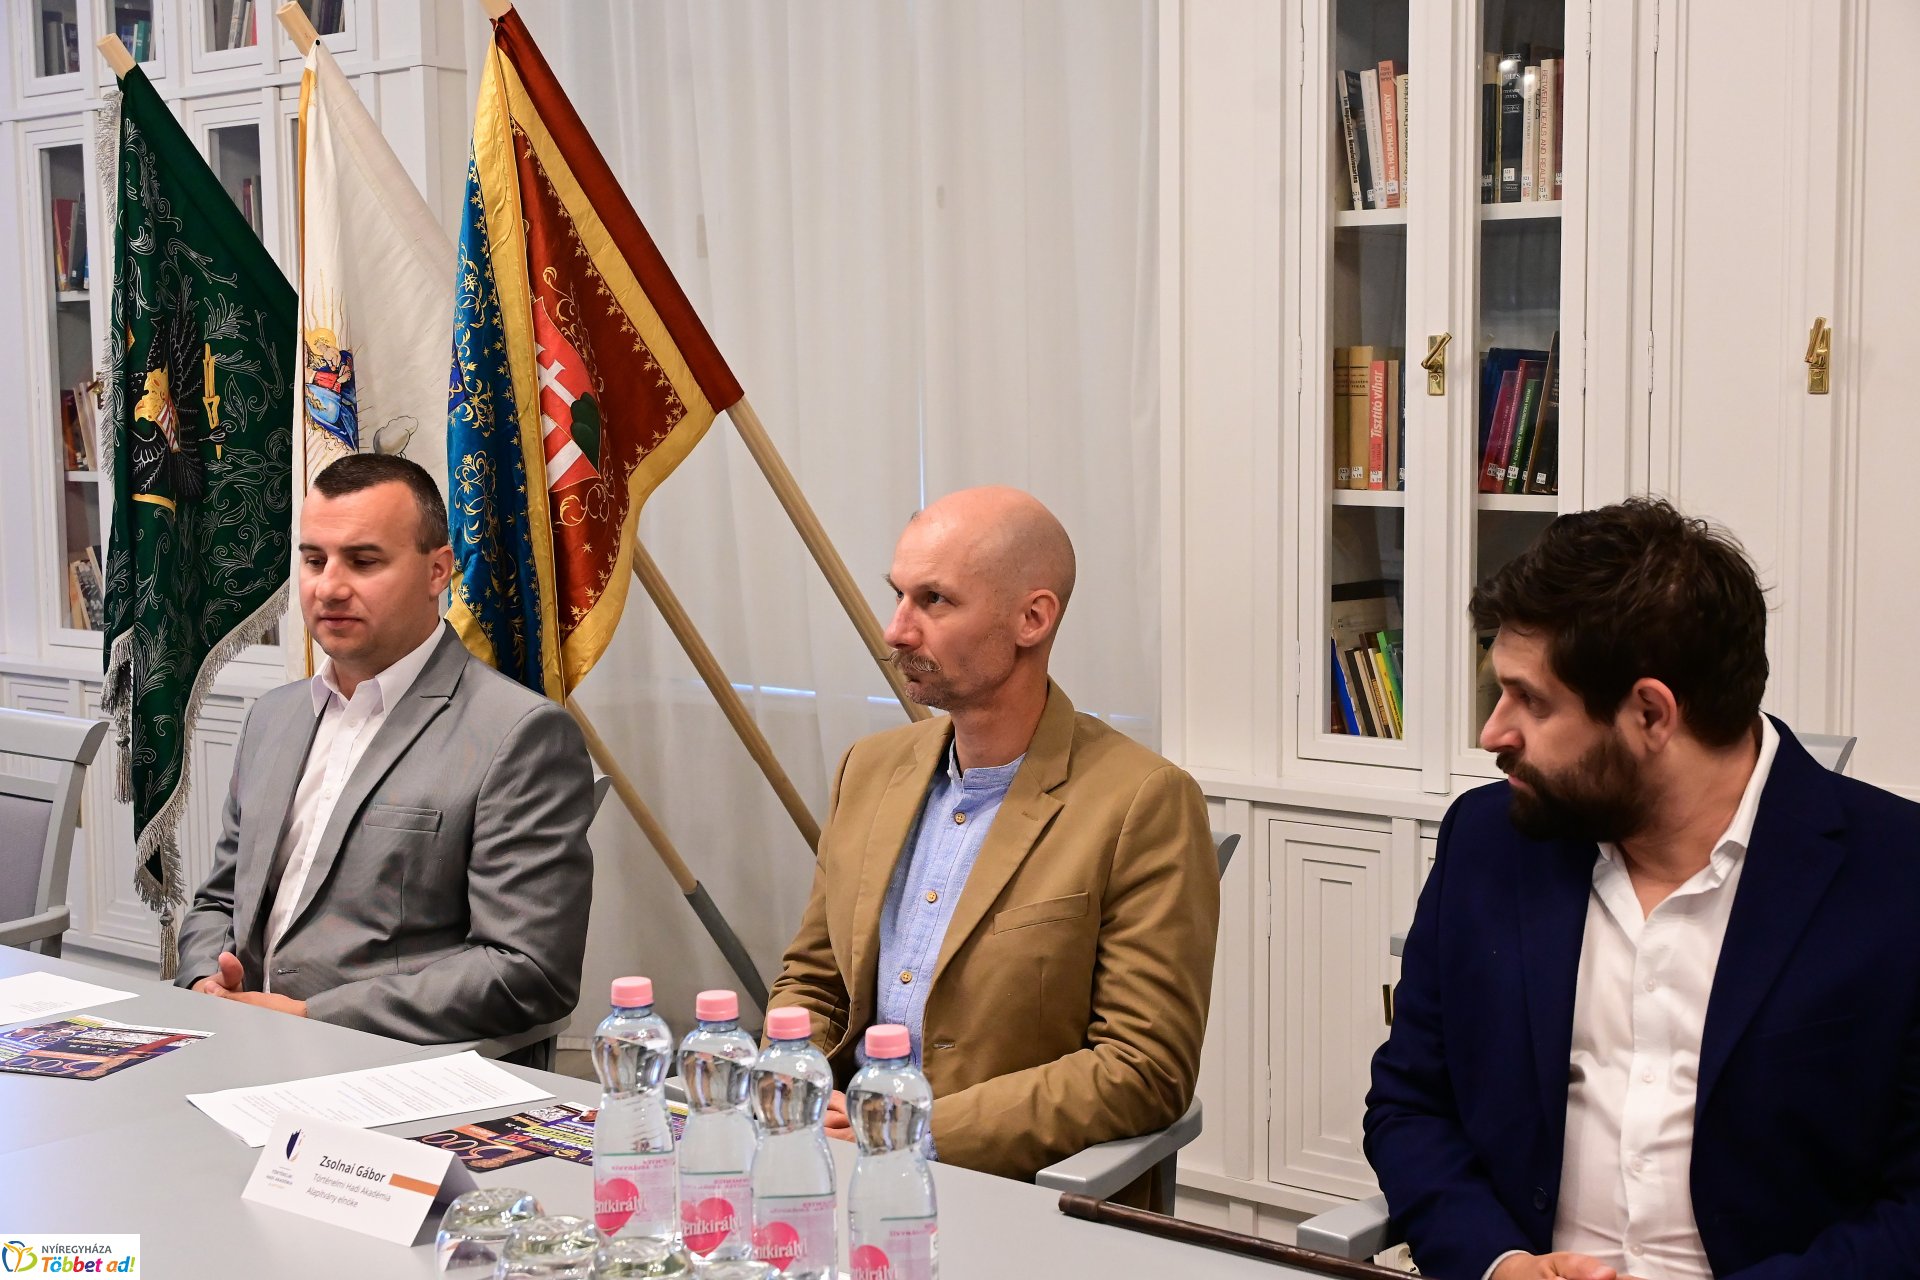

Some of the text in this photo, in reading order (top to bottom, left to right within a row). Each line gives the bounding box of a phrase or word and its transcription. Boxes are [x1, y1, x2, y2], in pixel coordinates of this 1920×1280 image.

[1384, 93, 1392, 120] BOIGNY
[1371, 370, 1384, 399] vihar
[319, 1155, 386, 1182] Zsolnai Gábor
[306, 1187, 359, 1207] Alapítvány elnöke
[313, 1173, 391, 1202] Történelmi Hadi Akadémia
